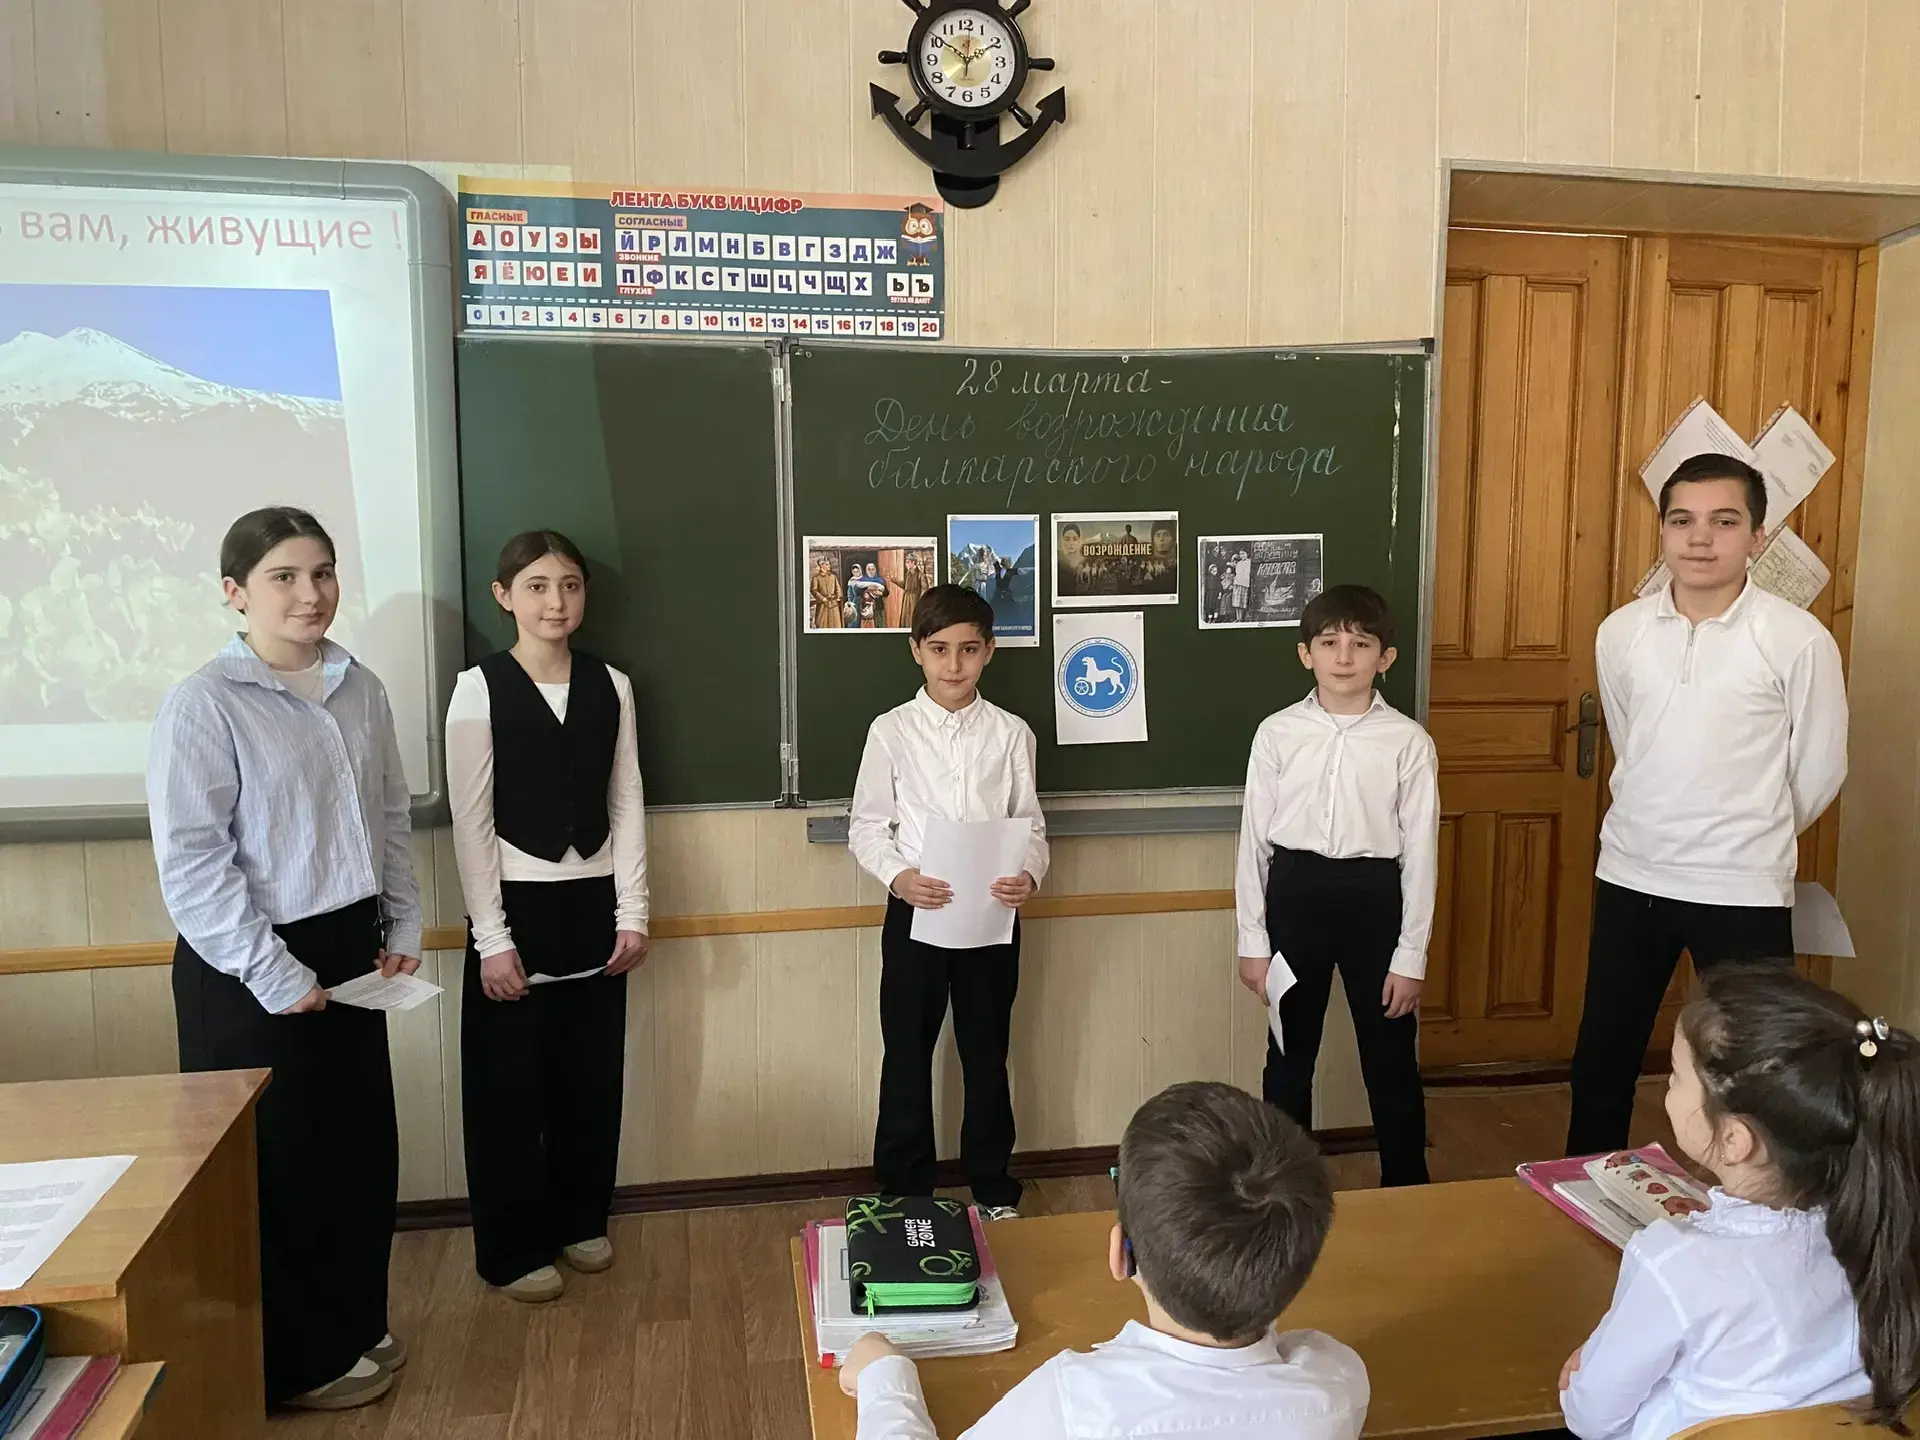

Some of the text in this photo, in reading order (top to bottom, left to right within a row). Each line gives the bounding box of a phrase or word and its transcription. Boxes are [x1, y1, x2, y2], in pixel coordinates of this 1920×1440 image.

[943, 24, 954, 35] 11
[959, 19, 973, 31] 12
[980, 25, 984, 35] 1
[931, 36, 943, 48] 10
[990, 37, 1001, 49] 2
[926, 54, 938, 66] 9
[995, 57, 1006, 68] 3
[931, 72, 943, 83] 8
[991, 73, 1001, 84] 4
[945, 86, 956, 97] 7
[962, 90, 973, 102] 6
[980, 86, 991, 98] 5
[610, 191, 803, 214] ЛЕНТА БУКВ И ЦИФР
[470, 211, 524, 222] ГЛАСНЫЕ
[618, 216, 684, 227] СОГЛАСНЫЕ
[20, 210, 129, 251] вам,
[146, 214, 373, 256] живущие
[473, 230, 598, 249] А О У Э Ы
[621, 231, 895, 262] Й Р Л М Н Б В Г З Д Ж
[618, 253, 660, 262] ЗВОНКИЕ
[474, 262, 597, 282] Я Ё Ю Е И
[622, 269, 868, 293] П Ф К С Т Ш Ц Ч Щ Х
[893, 278, 930, 293] Ь Ъ
[619, 287, 653, 295] ГЛУХИЕ
[473, 309, 937, 332] 0 1 2 3 4 5 6 7 8 9 10 11 12 13 14 15 16 17 18 19 20
[957, 358, 1002, 396] 28
[864, 397, 1296, 460] День возрождения
[867, 443, 1343, 508] балкарского народа
[1083, 543, 1152, 556] ВОЗРОЖДЕНИЕ
[904, 1218, 919, 1247] GAMER
[916, 1219, 936, 1247] ZONE
